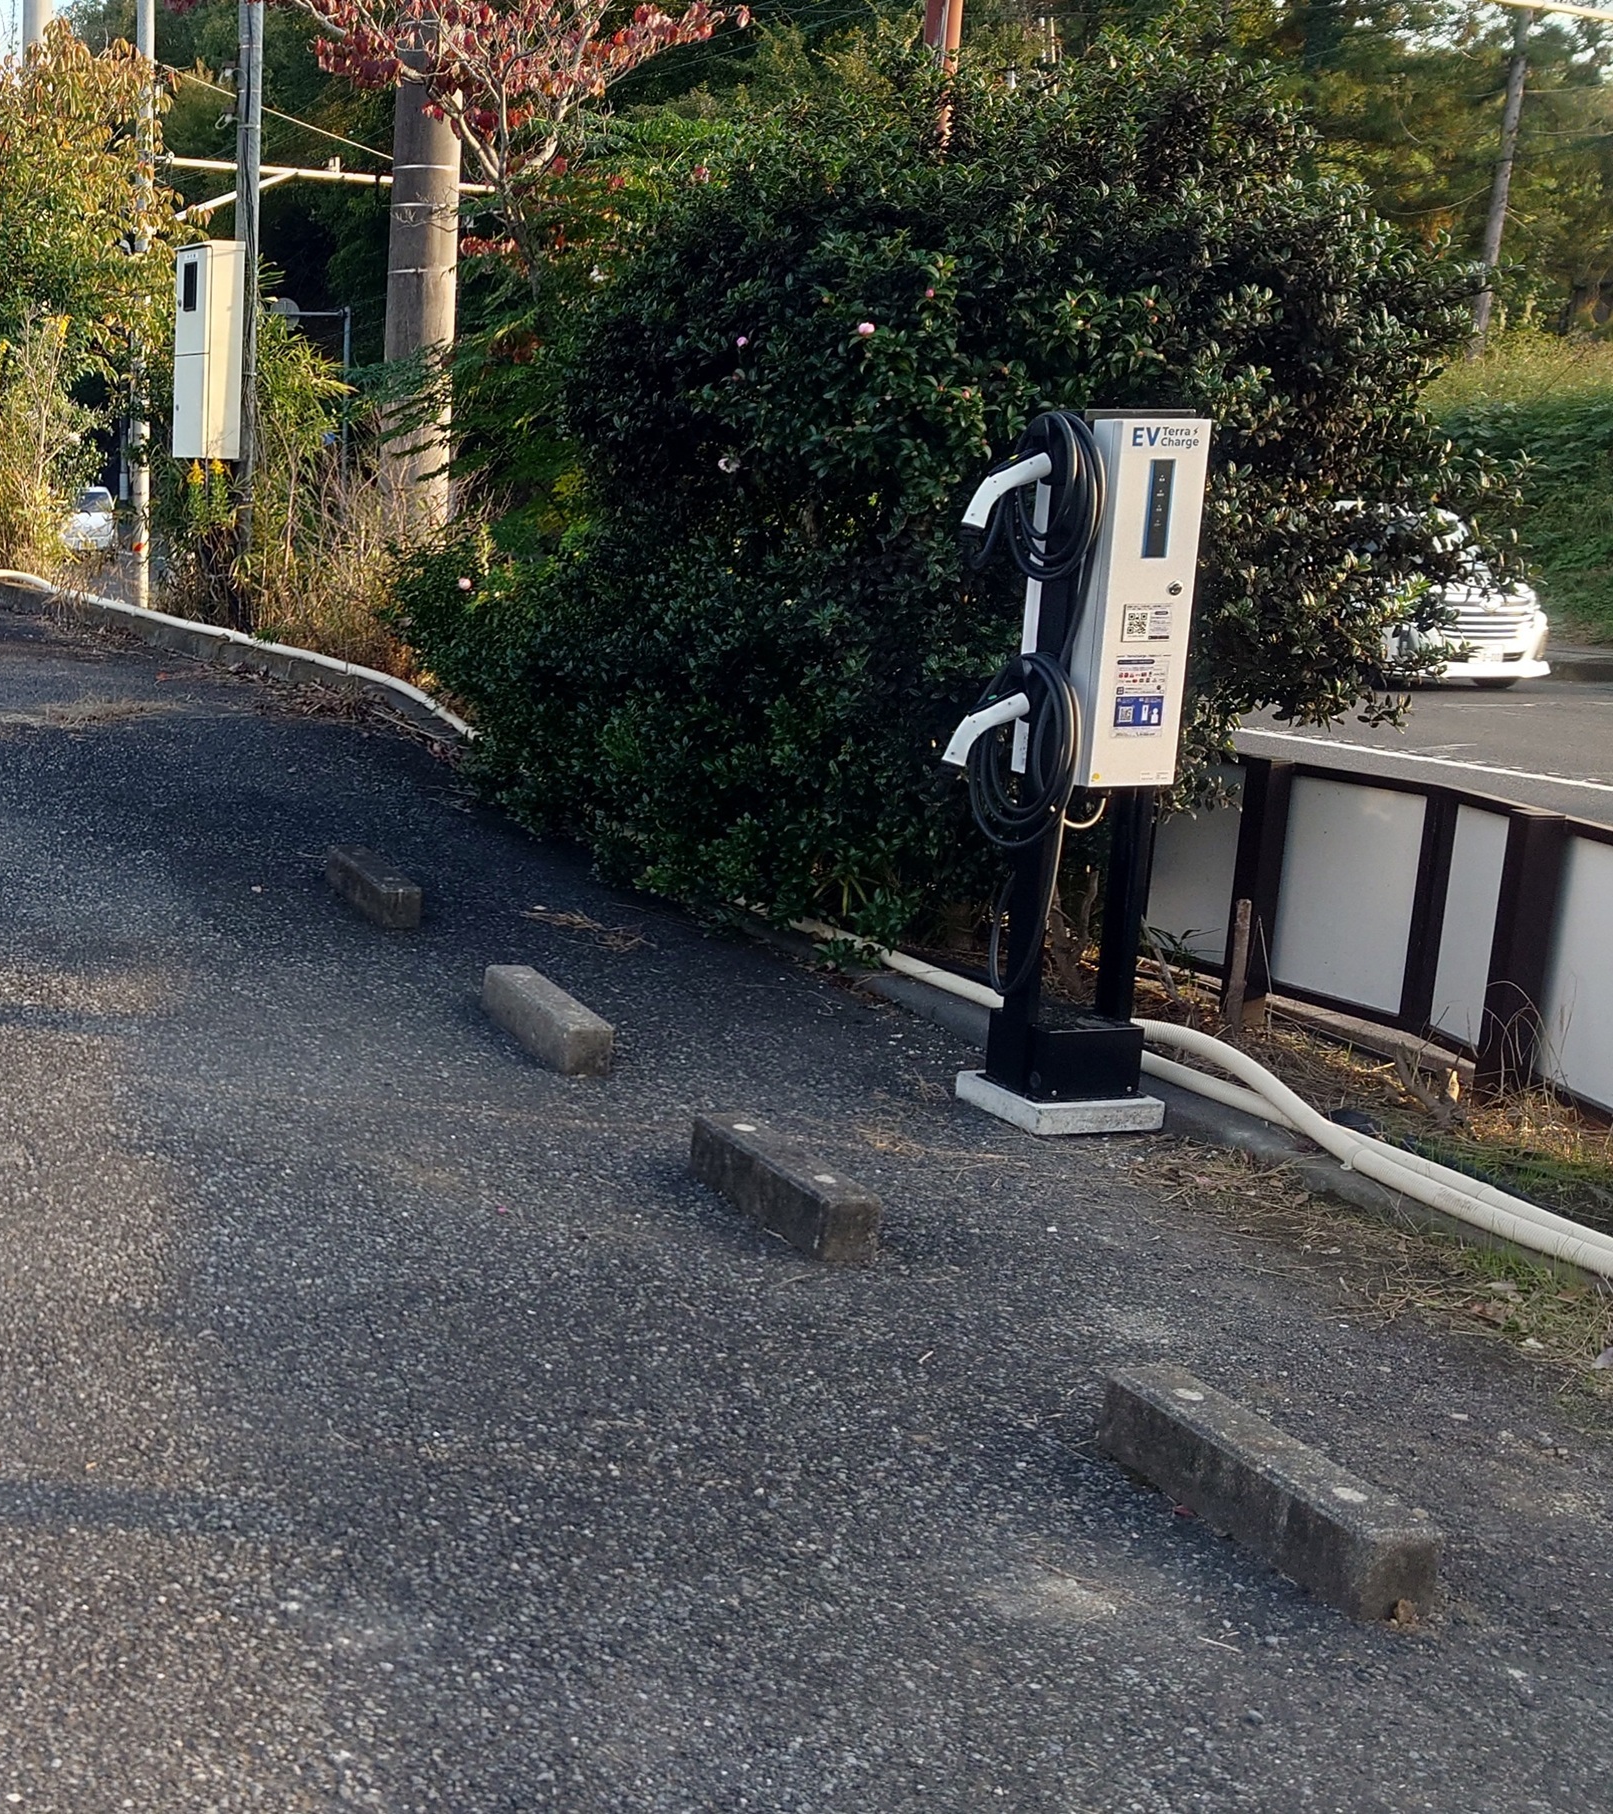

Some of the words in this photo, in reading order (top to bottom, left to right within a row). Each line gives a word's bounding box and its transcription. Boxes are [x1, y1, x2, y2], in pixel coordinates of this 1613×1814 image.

[1132, 426, 1161, 447] EV
[1162, 426, 1191, 436] Terra
[1160, 436, 1200, 449] Charge
